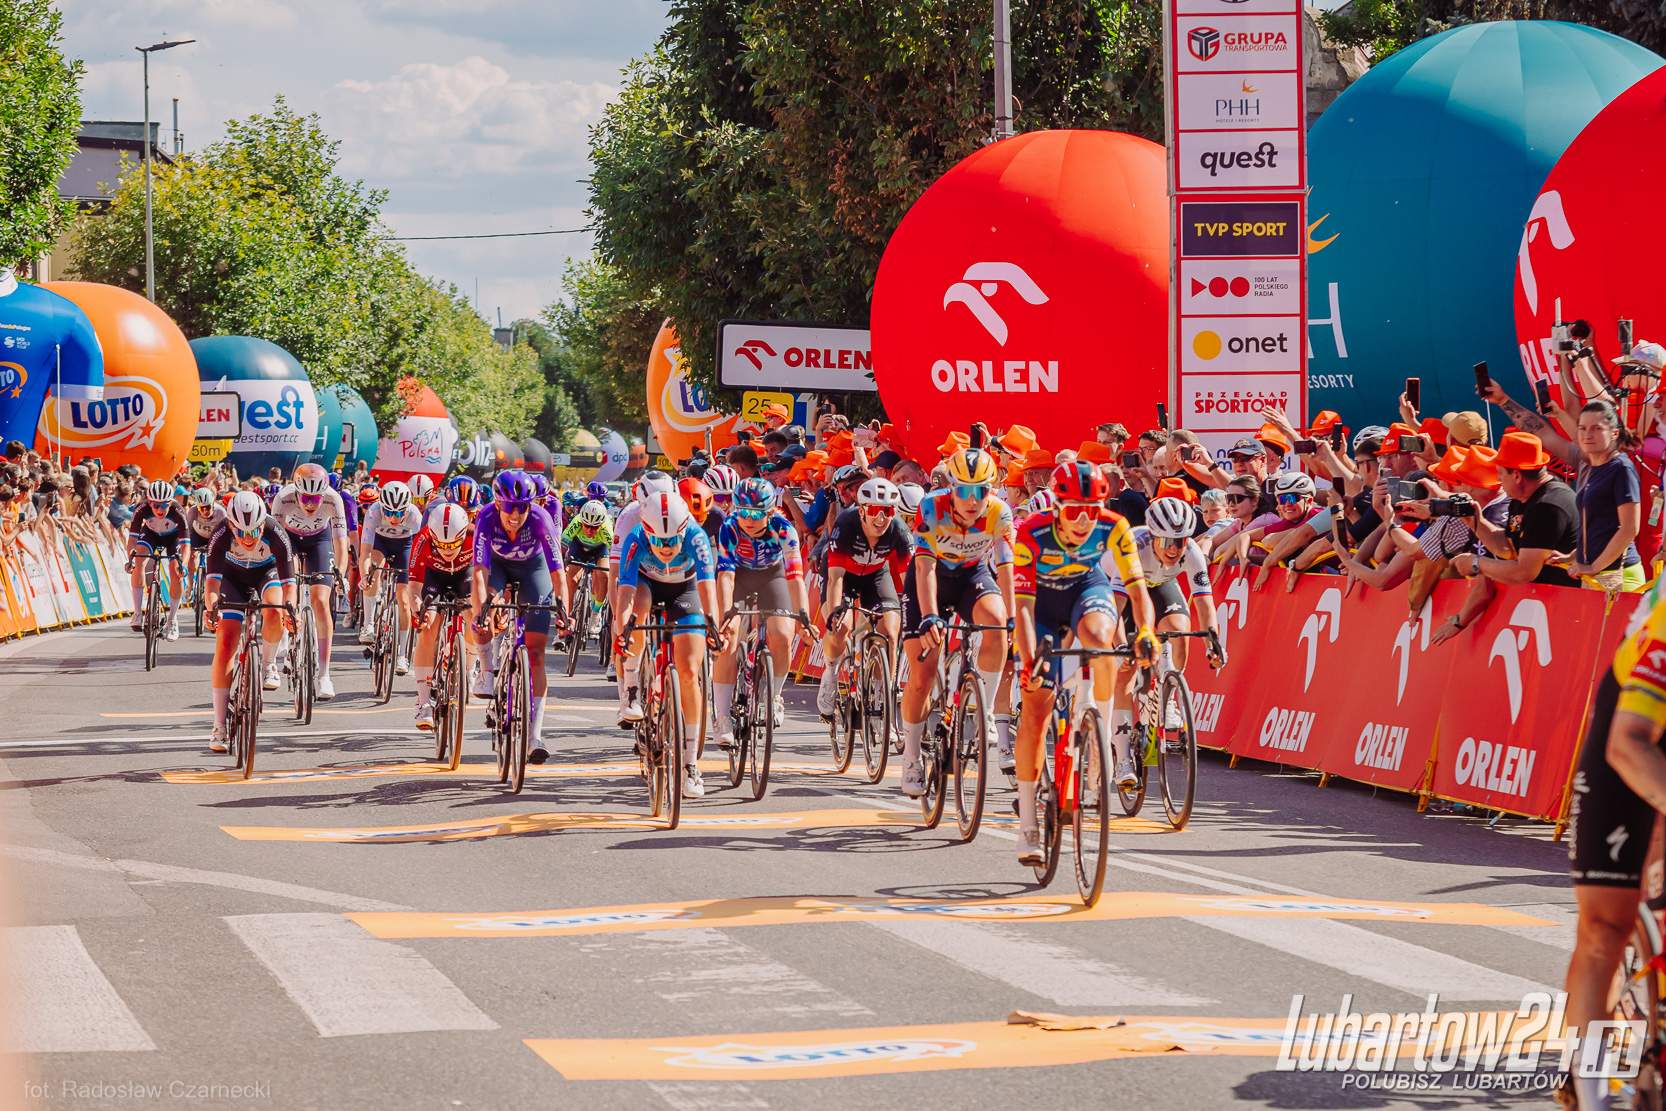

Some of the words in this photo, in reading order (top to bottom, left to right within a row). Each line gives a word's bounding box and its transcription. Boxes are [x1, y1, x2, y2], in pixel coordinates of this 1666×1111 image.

[1223, 32, 1288, 45] GRUPA
[1215, 98, 1260, 116] PHH
[1200, 142, 1279, 177] quest
[1194, 222, 1226, 237] TVP
[1232, 222, 1287, 237] SPORT
[1227, 333, 1288, 353] onet
[783, 346, 873, 371] ORLEN
[931, 359, 1059, 393] ORLEN
[1308, 374, 1355, 389] ESORTY
[71, 393, 144, 430] LOTTO
[198, 408, 231, 424] LEN
[241, 385, 304, 430] est
[748, 397, 789, 416] 25
[1194, 399, 1288, 413] SPORTOWY
[234, 433, 300, 445] estsport.cc
[475, 532, 487, 563] Jayco
[1259, 706, 1316, 753] ORLEN
[1354, 721, 1410, 772] ORLEN
[1454, 736, 1537, 798] ORLEN
